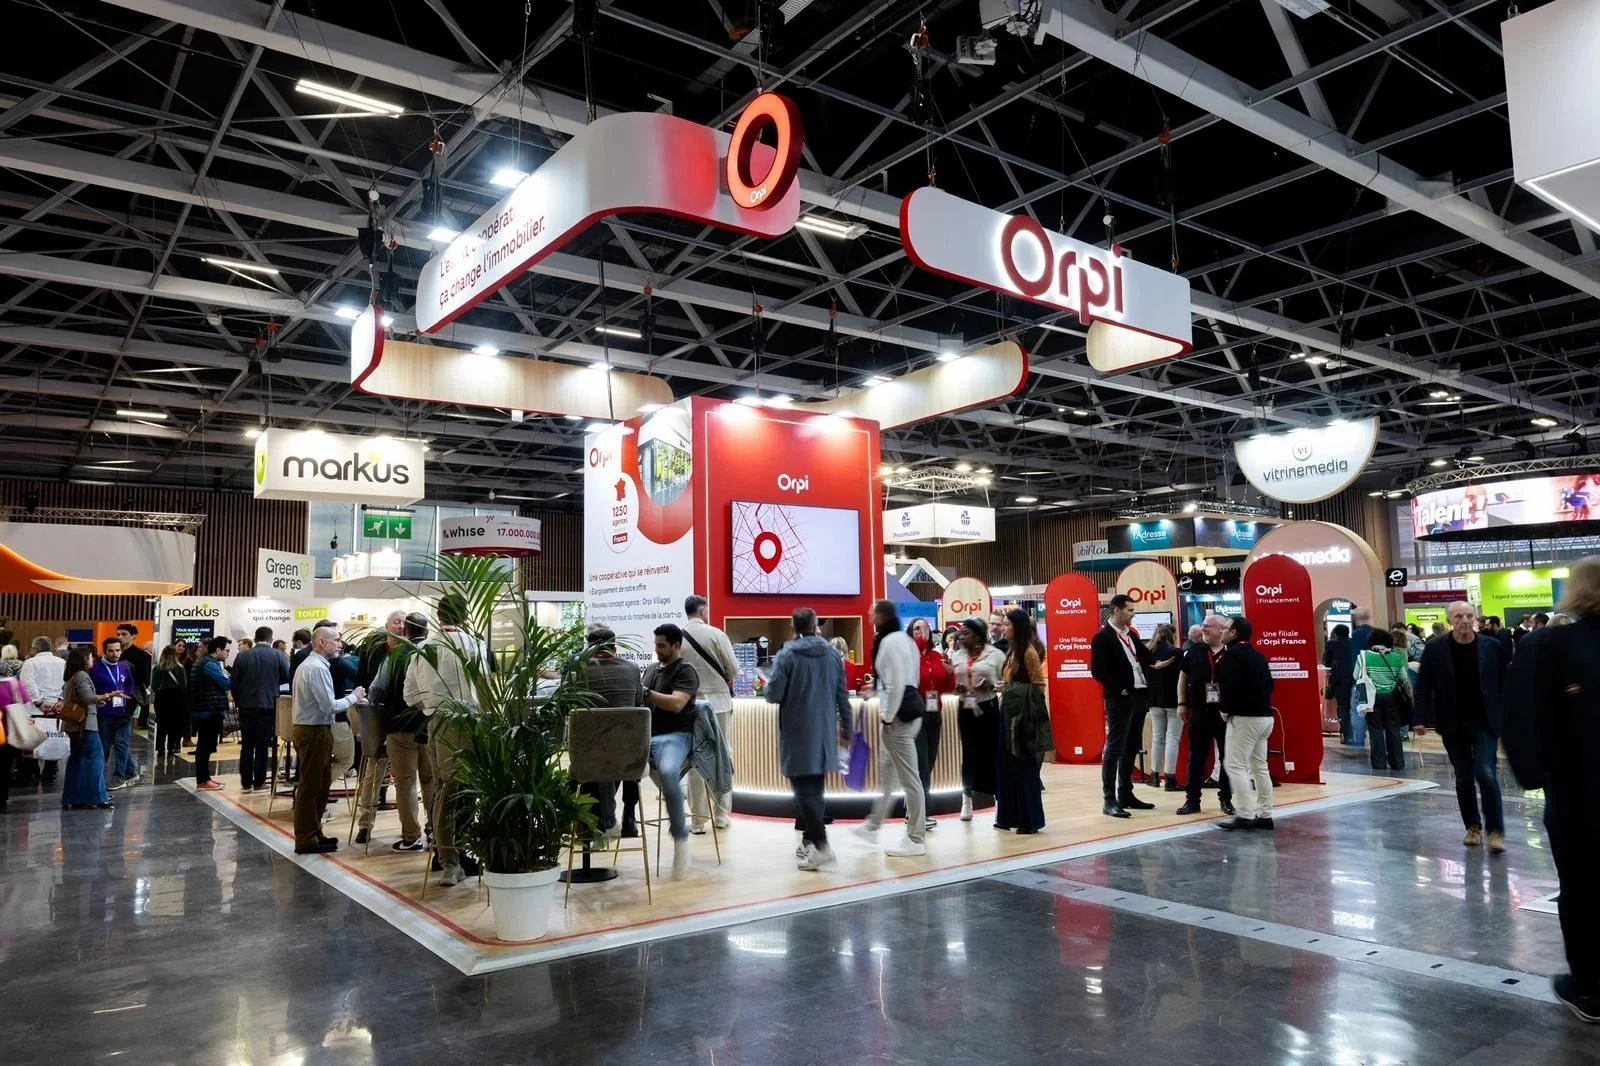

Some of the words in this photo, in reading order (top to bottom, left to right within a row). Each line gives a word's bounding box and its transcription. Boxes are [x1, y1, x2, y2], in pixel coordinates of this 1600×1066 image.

[749, 184, 767, 203] Orpi
[440, 286, 449, 310] ça
[450, 264, 482, 297] change
[483, 216, 546, 273] l'immobilier.
[1001, 214, 1123, 326] Orpi
[589, 447, 612, 468] Orpi
[283, 452, 409, 485] markus
[1263, 459, 1348, 481] vitrinemedia
[777, 473, 809, 494] Orpi
[613, 504, 628, 518] 1250
[1416, 498, 1472, 526] Talent
[450, 526, 486, 538] whise
[950, 528, 981, 537] PriceHubble
[1133, 529, 1167, 544] l'Adresse
[265, 557, 298, 577] Green
[589, 573, 598, 582] Une
[599, 570, 628, 581] coopérative
[628, 568, 637, 579] qui
[273, 576, 301, 590] acres
[636, 583, 647, 591] offre
[1127, 584, 1166, 605] Orpi
[1256, 584, 1282, 597] Orpi
[642, 597, 652, 606] Orpi
[951, 599, 982, 615] Orpi
[1060, 598, 1081, 609] Orpi
[167, 603, 219, 617] markus
[296, 610, 321, 619] TOUT
[265, 615, 291, 623] change
